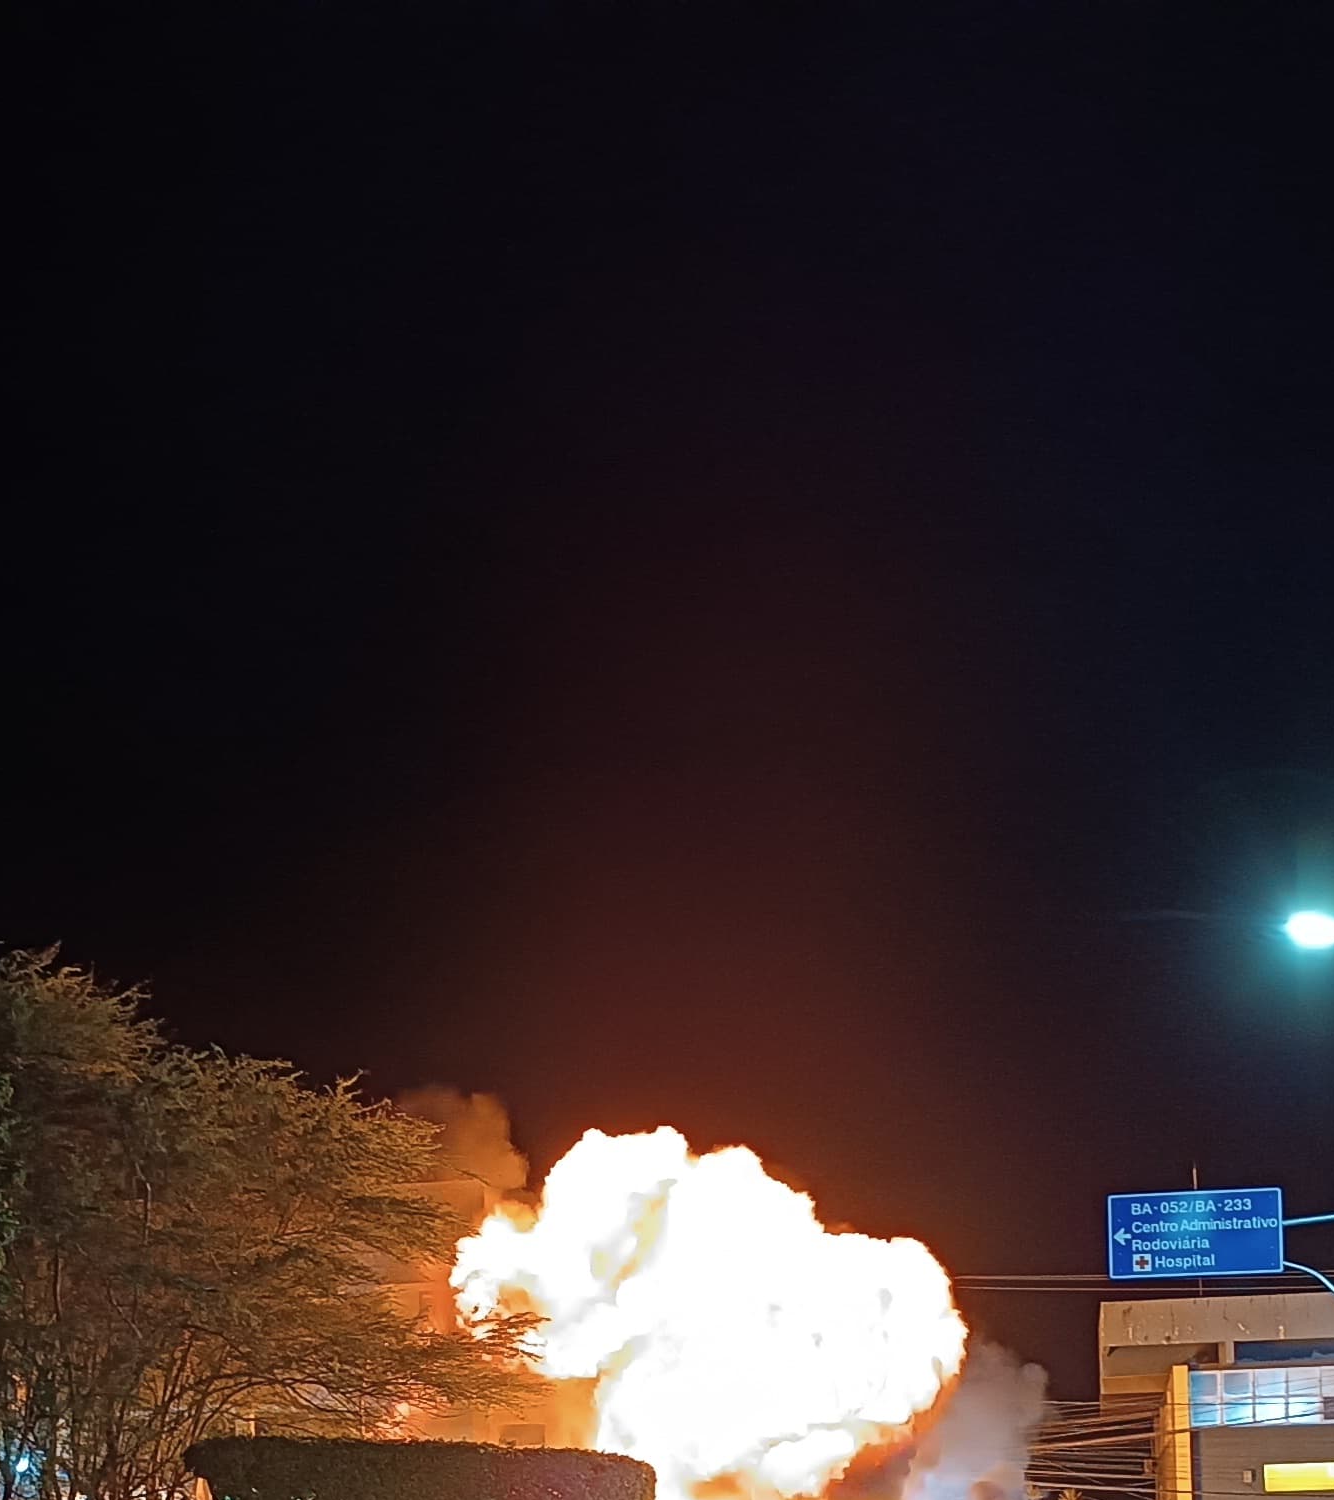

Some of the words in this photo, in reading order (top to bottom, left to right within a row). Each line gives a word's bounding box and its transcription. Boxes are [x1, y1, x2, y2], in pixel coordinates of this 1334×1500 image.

[1132, 1221, 1179, 1235] Centro
[1180, 1216, 1278, 1232] Administrativo
[1132, 1235, 1210, 1251] Rodoviária
[1155, 1254, 1216, 1270] Hospital
